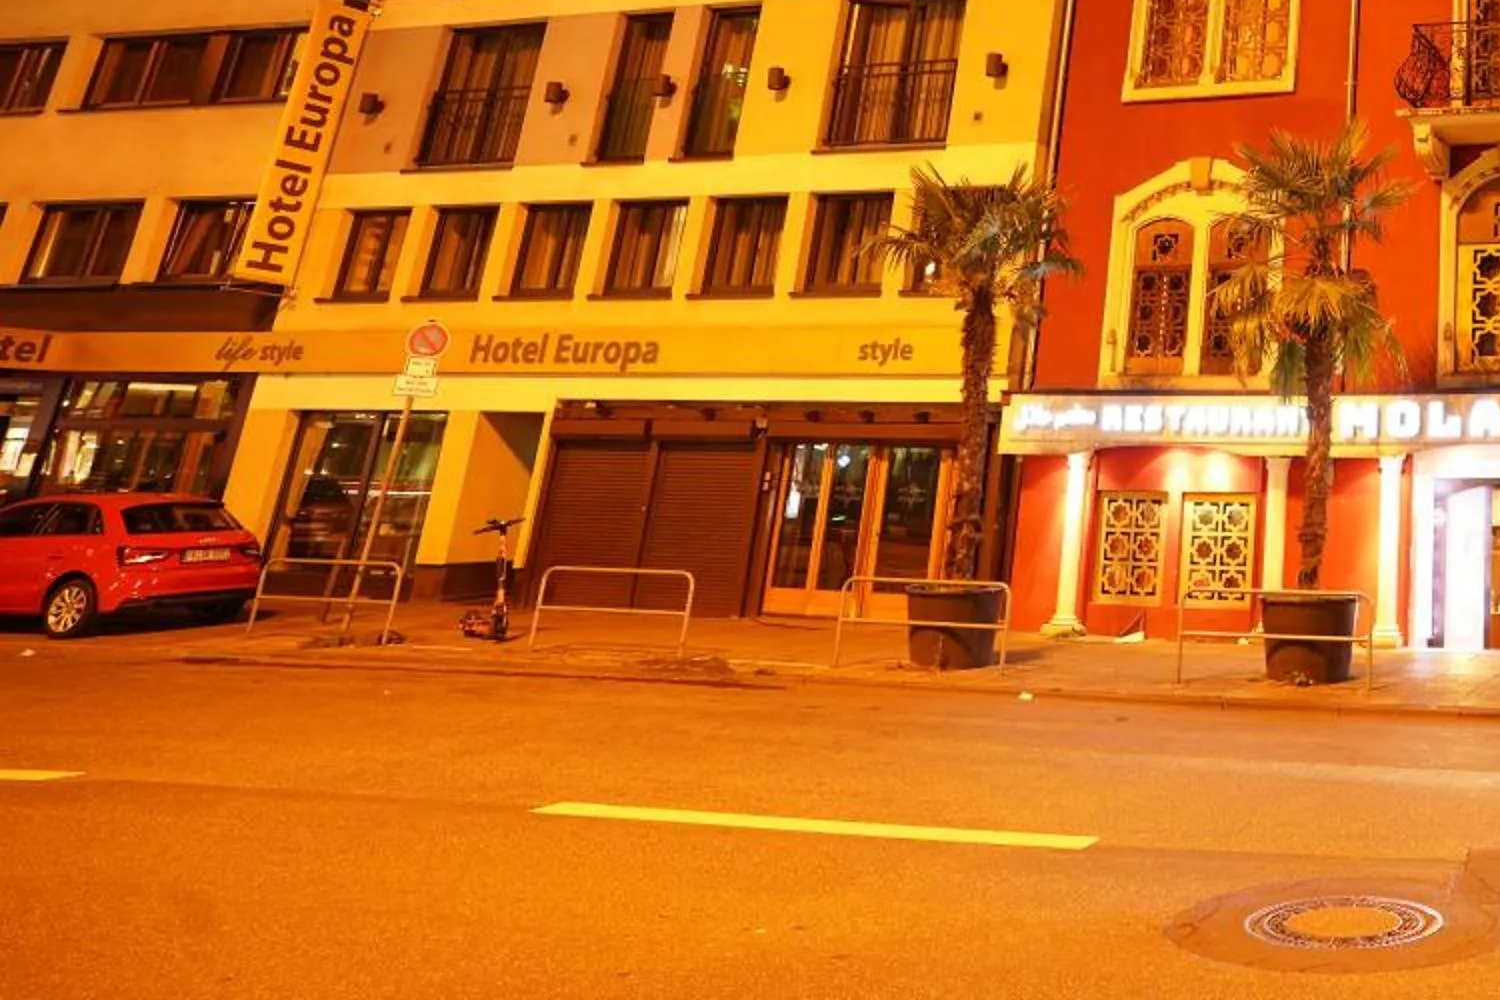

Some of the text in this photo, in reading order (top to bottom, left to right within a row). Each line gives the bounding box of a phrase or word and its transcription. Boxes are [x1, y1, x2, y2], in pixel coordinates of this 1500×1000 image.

[245, 14, 357, 273] Hotel Europa
[214, 336, 304, 371] life style
[469, 332, 660, 373] Hotel Europa
[857, 336, 914, 368] style
[1101, 402, 1310, 437] RESTAURAN
